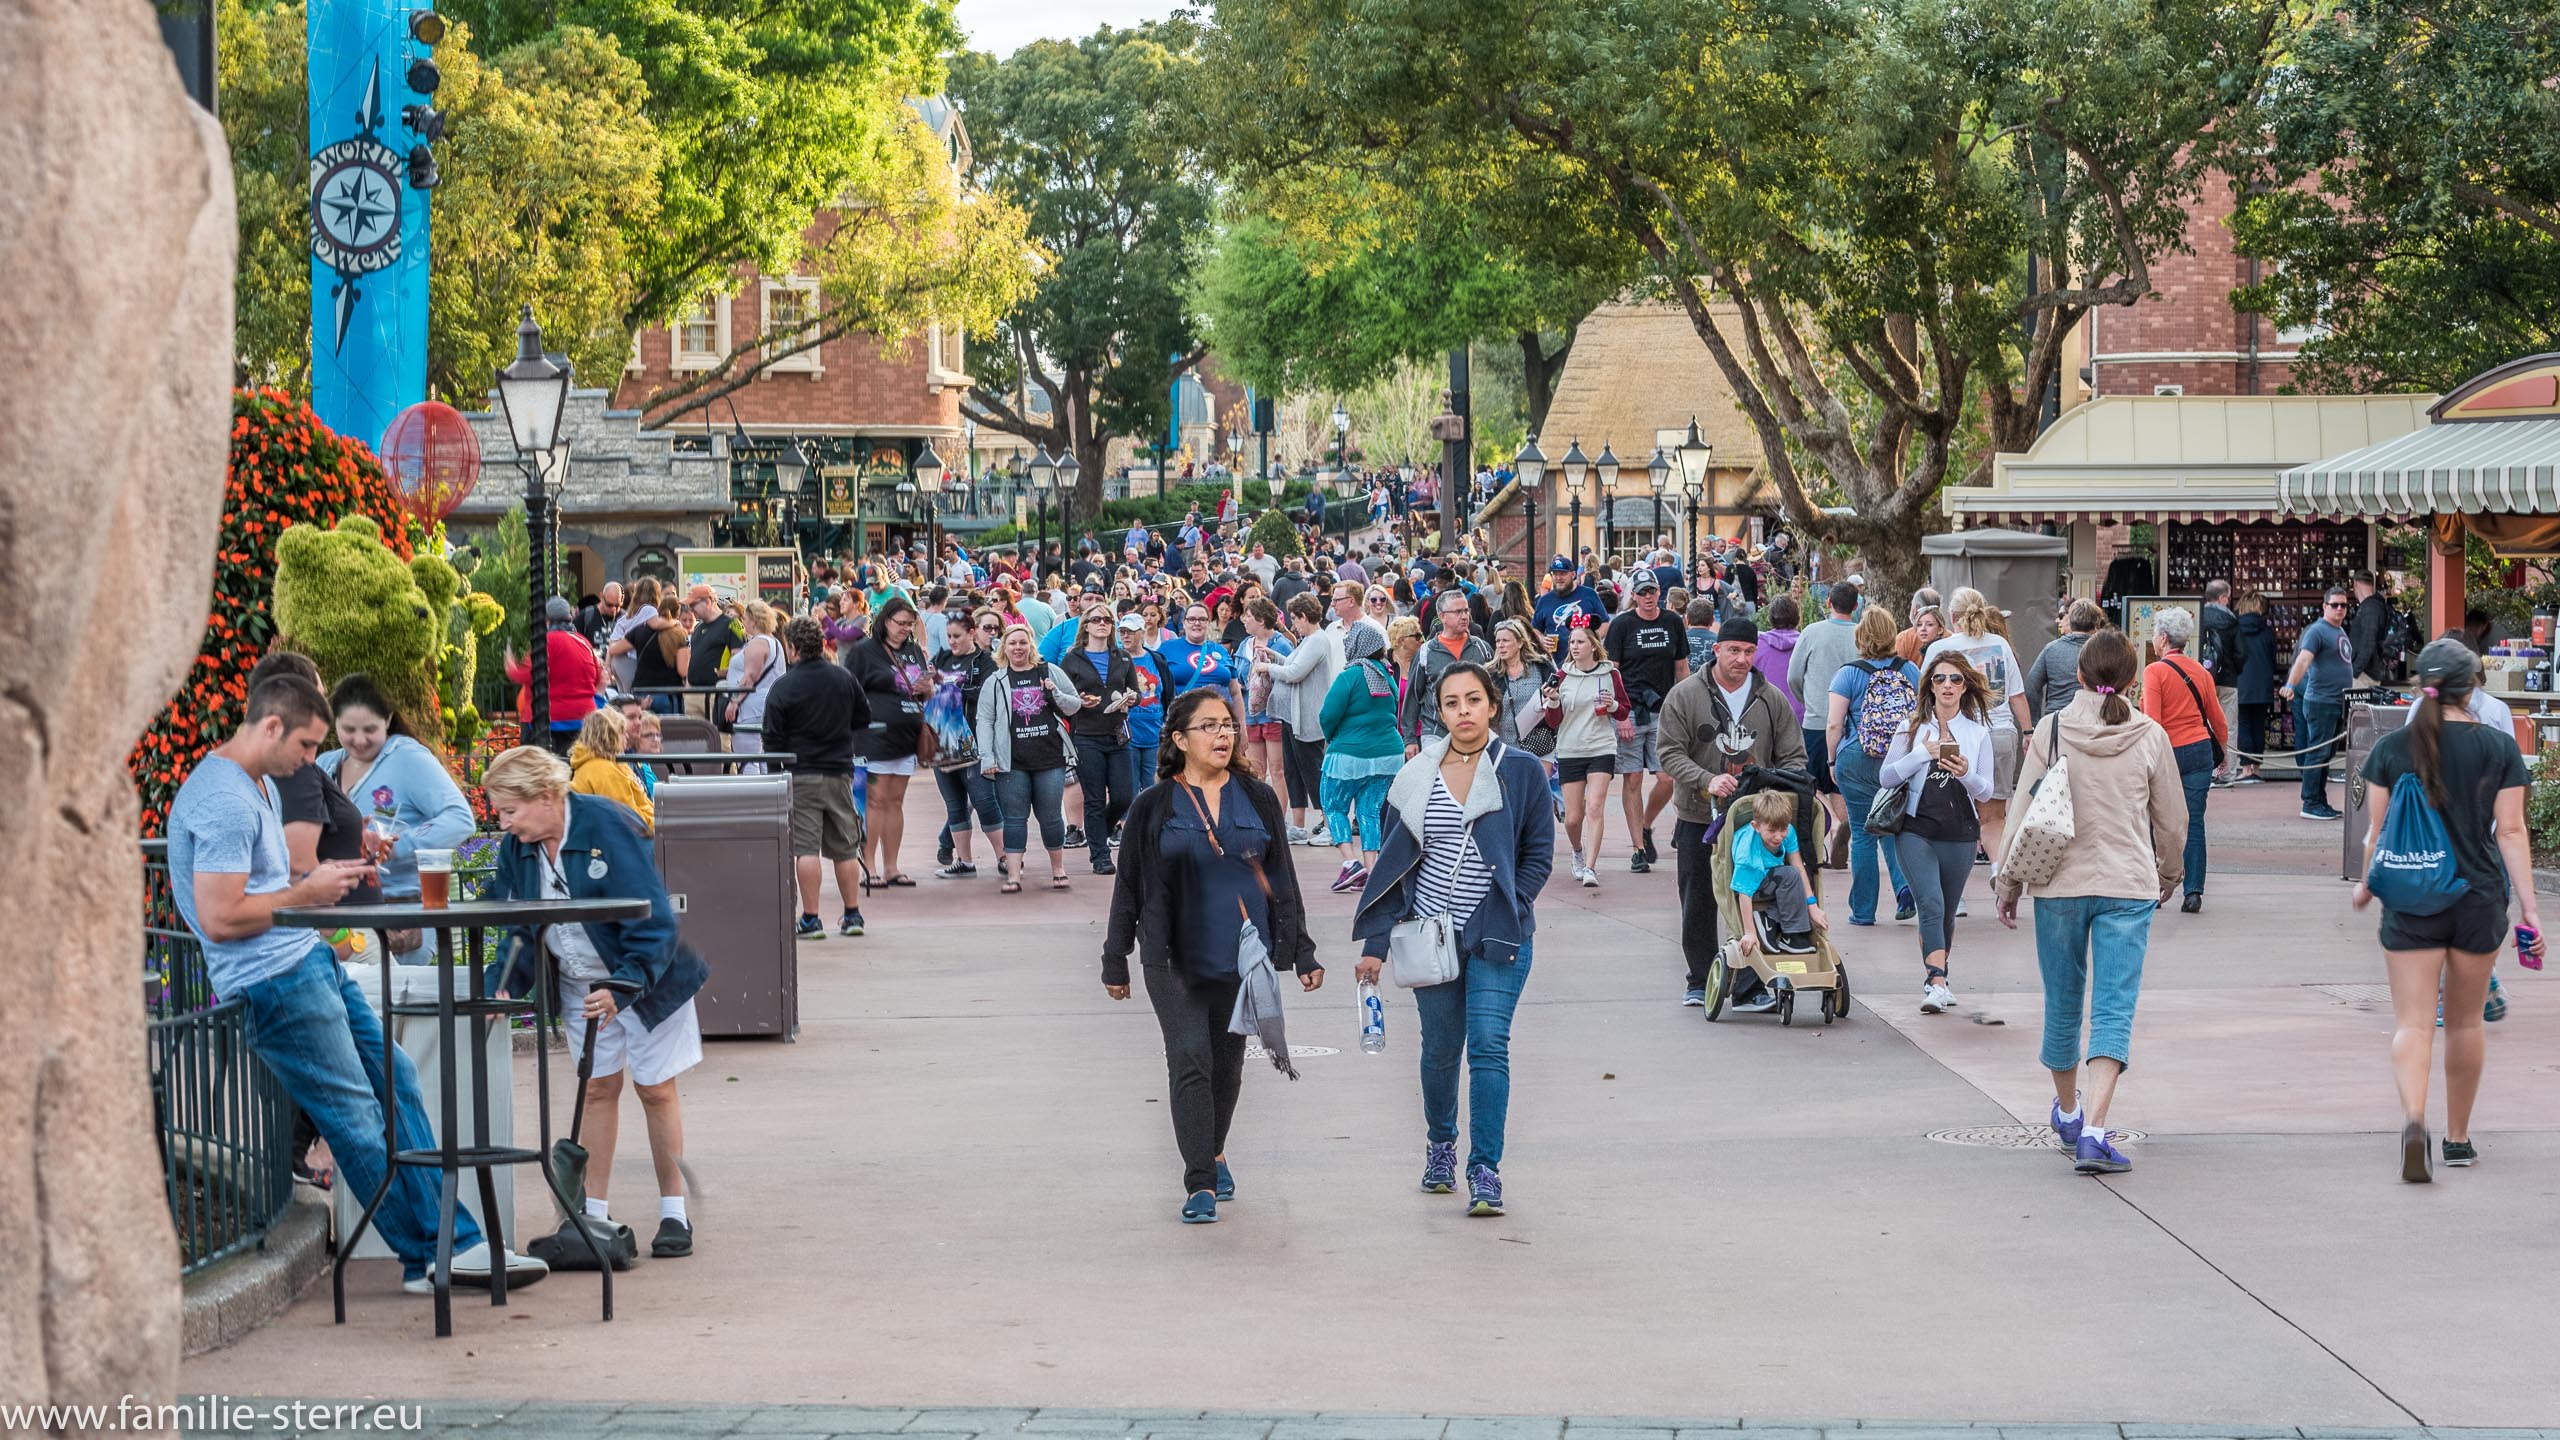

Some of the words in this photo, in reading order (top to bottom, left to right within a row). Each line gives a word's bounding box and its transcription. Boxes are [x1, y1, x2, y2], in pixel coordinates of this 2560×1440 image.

[1926, 766, 1955, 788] ays
[2384, 849, 2408, 863] Penn
[2408, 849, 2446, 863] Medicine
